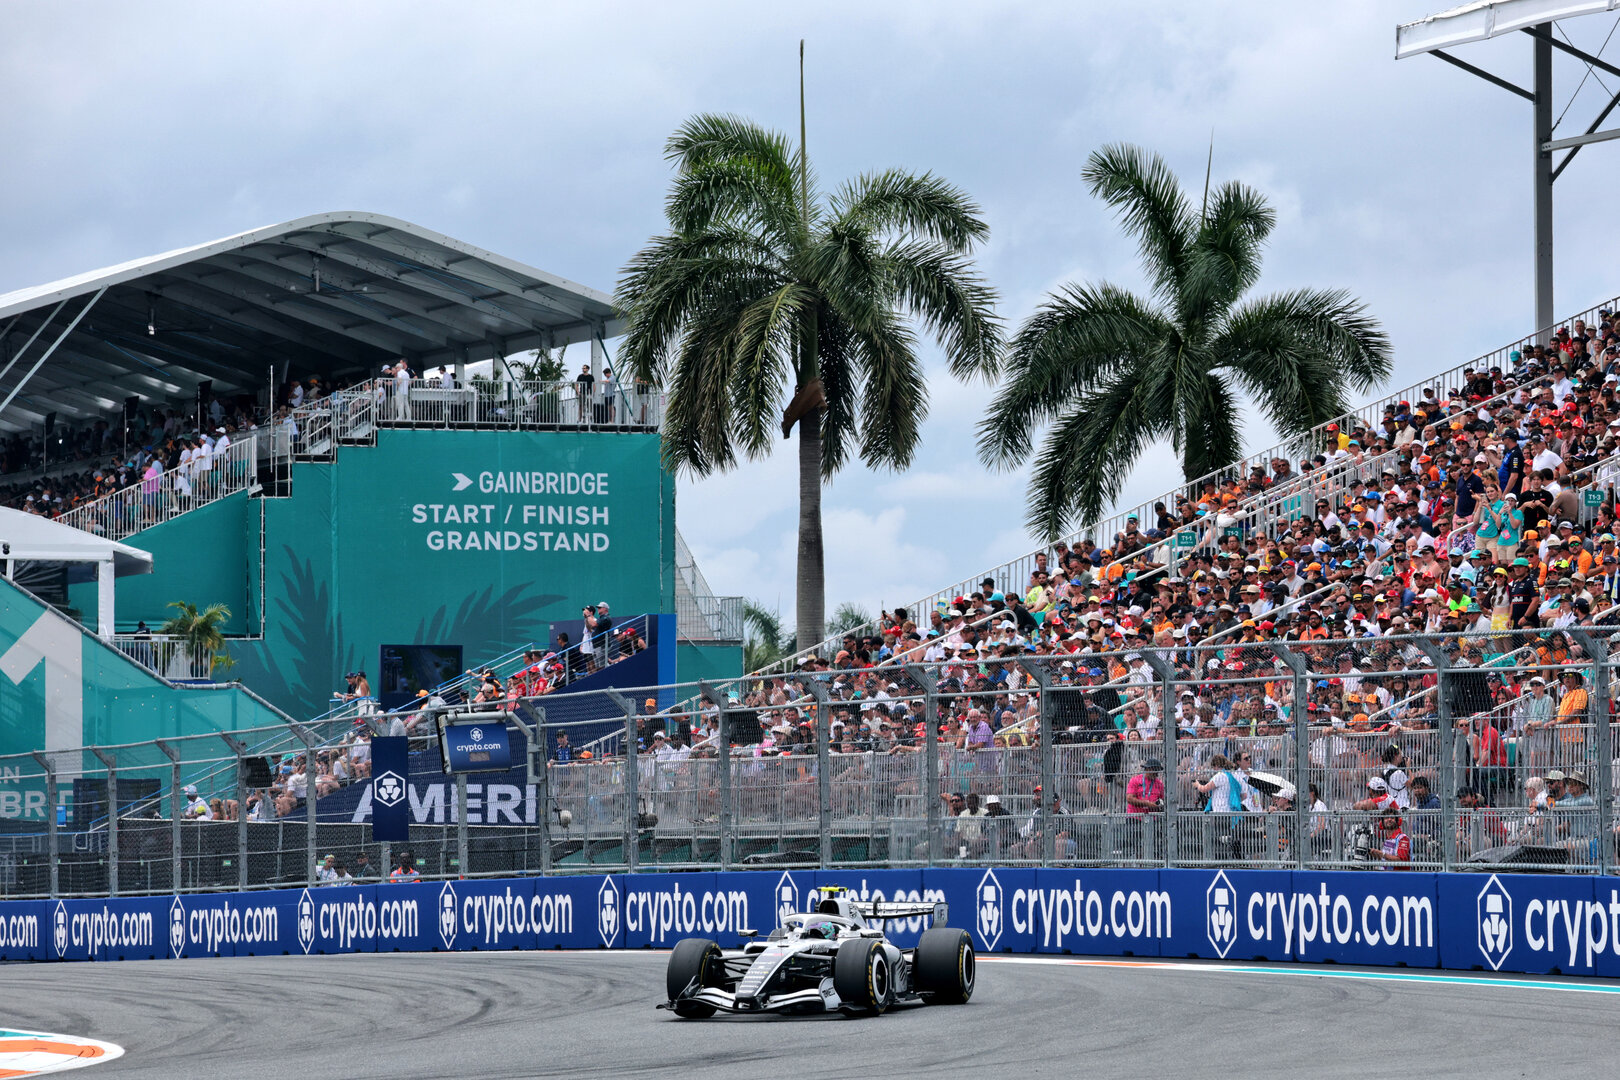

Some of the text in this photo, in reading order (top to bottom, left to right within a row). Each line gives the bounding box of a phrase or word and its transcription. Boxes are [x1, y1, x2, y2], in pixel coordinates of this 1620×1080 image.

[479, 471, 609, 495] GAINBRIDGE
[412, 504, 609, 525] START / FINISH
[426, 530, 610, 552] GRANDSTAND
[456, 742, 501, 753] crypto.com
[71, 905, 153, 955] crypto.com
[189, 901, 278, 953] crypto.com
[319, 893, 418, 948] crypto.com
[463, 886, 573, 944] crypto.com
[625, 882, 749, 943] crypto.com
[1011, 879, 1172, 948] crypto.com
[1247, 882, 1433, 955] crypto.com
